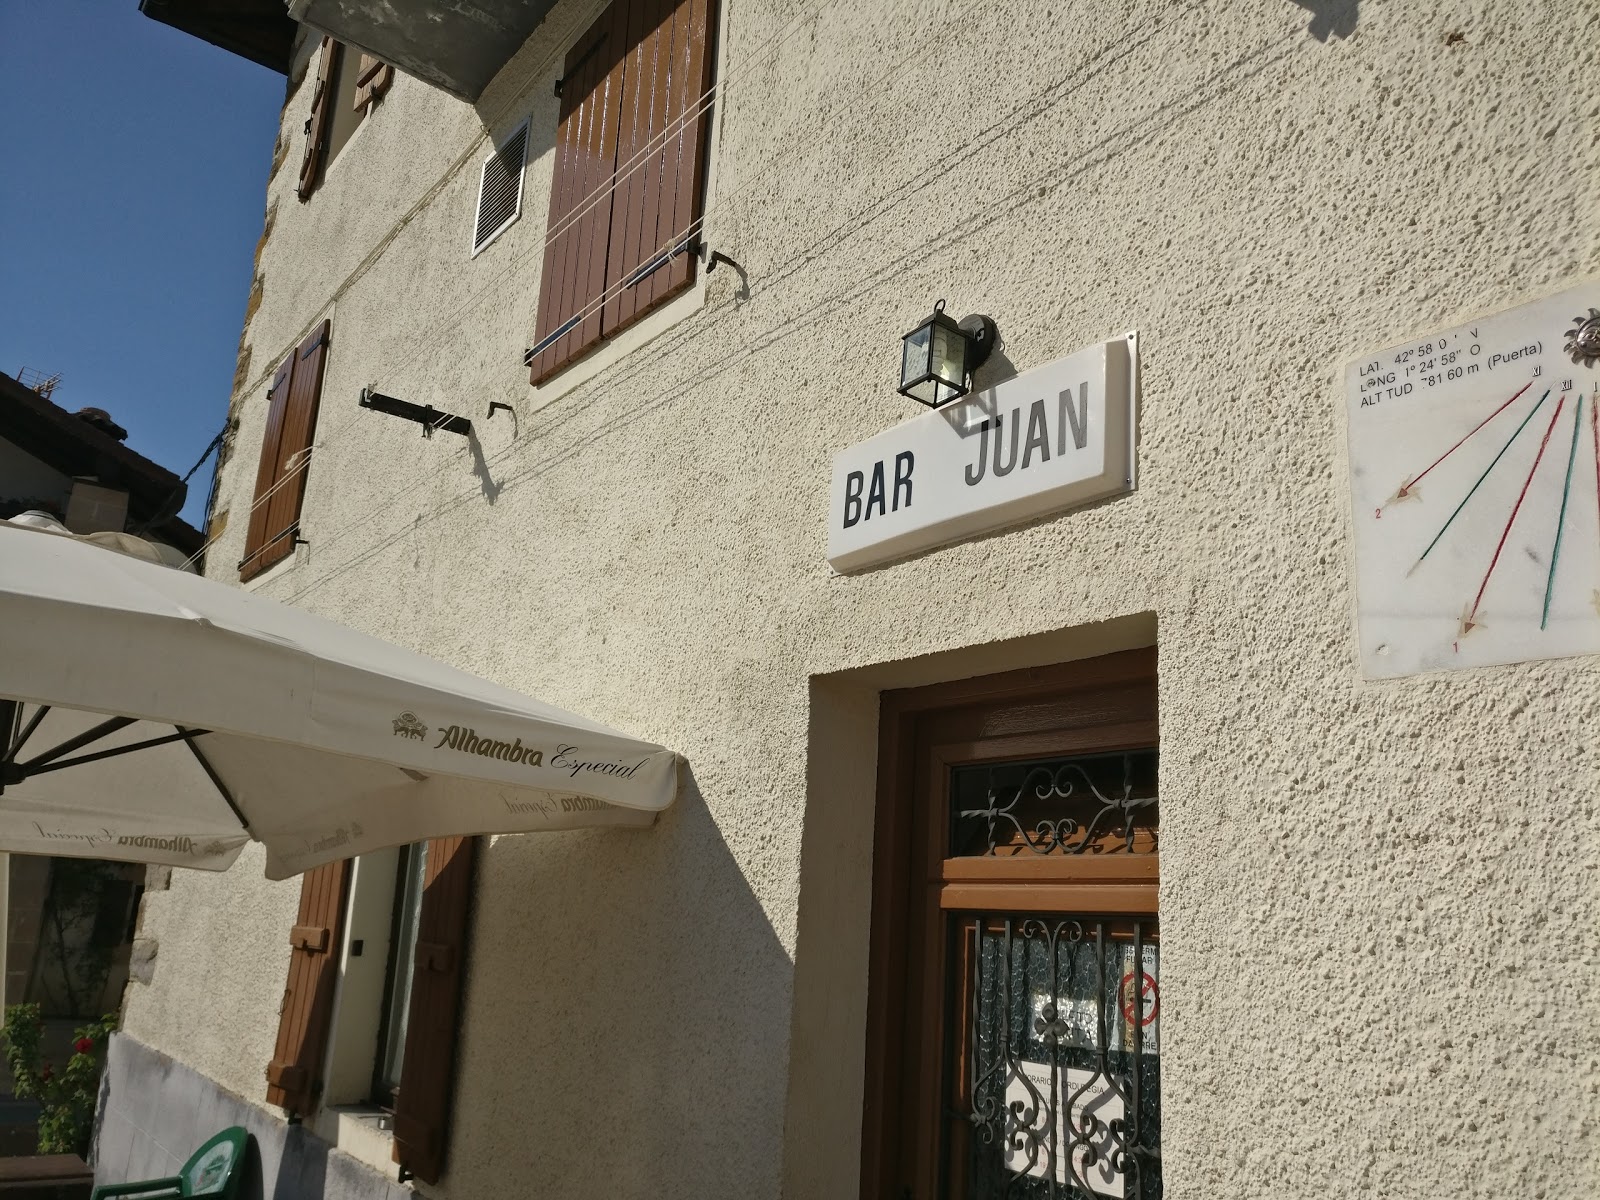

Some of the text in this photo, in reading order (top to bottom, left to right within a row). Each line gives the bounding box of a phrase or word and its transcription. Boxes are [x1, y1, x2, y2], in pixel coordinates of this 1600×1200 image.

[1467, 363, 1479, 375] m
[1487, 340, 1543, 371] (Puerta)
[1360, 372, 1396, 393] LNG
[843, 381, 1089, 530] BAR JUAN
[434, 724, 651, 780] Alhambra Especial
[1126, 955, 1154, 965] FUAR
